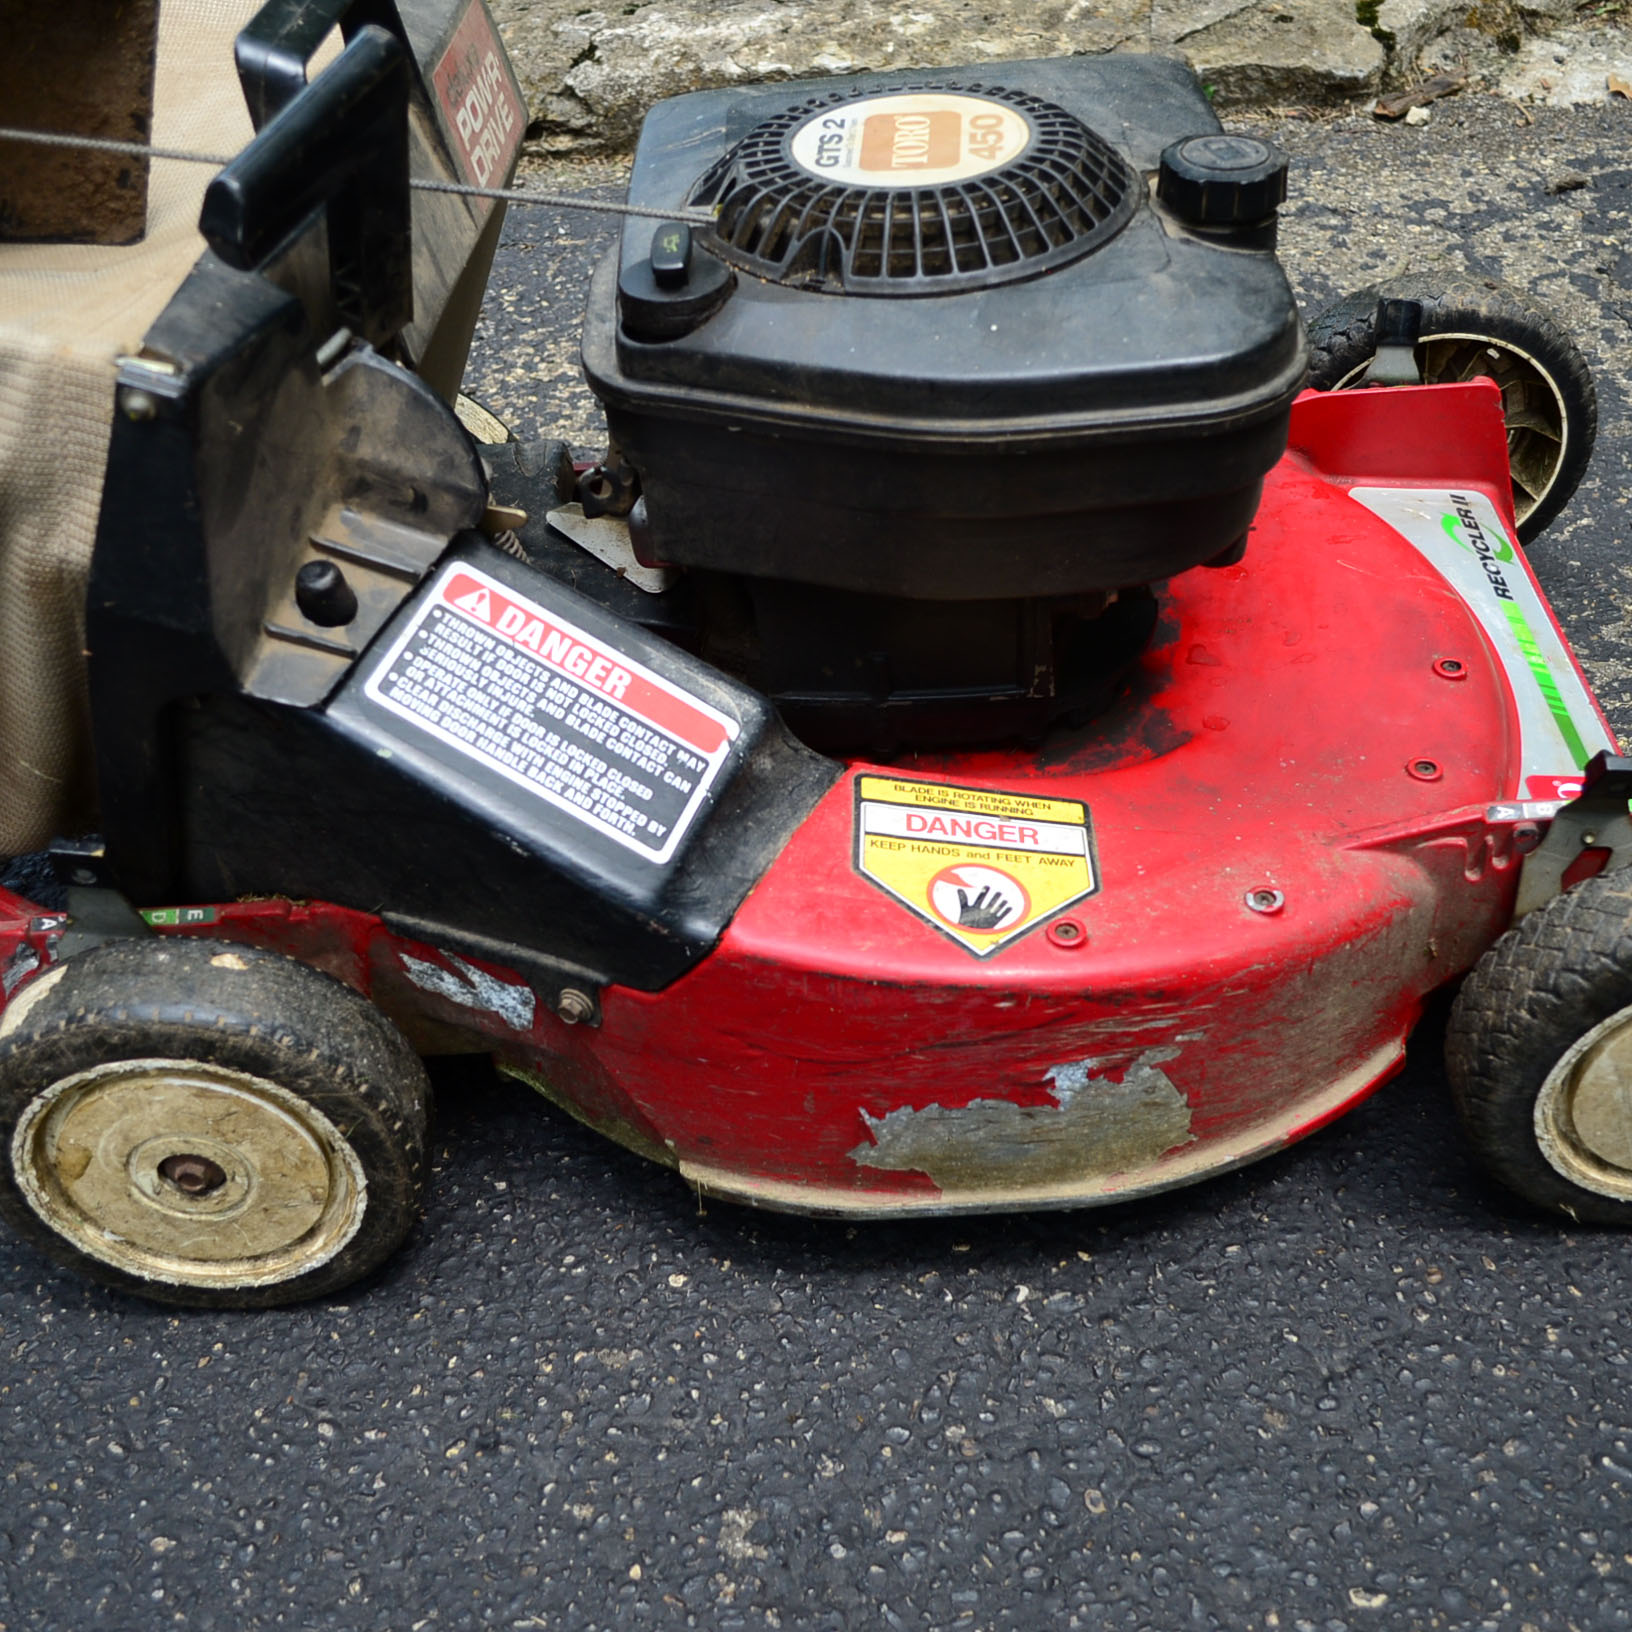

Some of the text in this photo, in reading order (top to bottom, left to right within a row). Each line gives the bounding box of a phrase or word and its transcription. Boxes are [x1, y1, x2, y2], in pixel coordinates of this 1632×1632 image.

[470, 91, 514, 188] DRIVE
[815, 118, 846, 169] GTS 2
[892, 115, 930, 169] TORO
[969, 114, 1004, 161] 450
[1451, 495, 1513, 600] RECYCLER II
[417, 643, 488, 690] SERIOUSLY
[432, 622, 483, 657] RESULT
[493, 657, 532, 686] DOOR
[543, 686, 573, 710] NOT
[570, 702, 621, 738] LOCKED
[495, 604, 632, 700] DANGER
[410, 654, 468, 694] OPERATE
[464, 685, 500, 712] ONLY
[509, 711, 547, 739] DOOR
[558, 739, 609, 775] LOCKED
[604, 765, 654, 801] CLOSED
[422, 675, 508, 731] ATTACHMENT
[519, 731, 571, 766] LOCKED
[424, 632, 692, 794] THROWN OBJECTS AND BLADE CONTACT CAN
[439, 612, 706, 773] THROWN OBJECTS AND BLADE CONTACT MAY
[388, 685, 442, 723] MOVING
[438, 714, 478, 743] DOOR
[474, 735, 529, 773] HANDLE
[525, 764, 565, 793] BACK
[562, 785, 595, 811] AND
[394, 675, 440, 707] CLEAR
[436, 698, 512, 748] DISCHARGE
[508, 740, 546, 768] WITH
[542, 759, 592, 795] ENGINE
[588, 786, 649, 828] STOPPED
[894, 784, 1051, 811] BLADE IS ROTATING WHEN
[906, 814, 1039, 845] DANGER
[915, 795, 1034, 816] ENGINE IS RUNNING
[870, 839, 1075, 868] KEEP HANDS and FEET AWAY
[41, 918, 58, 930] A
[151, 909, 203, 923] D E
